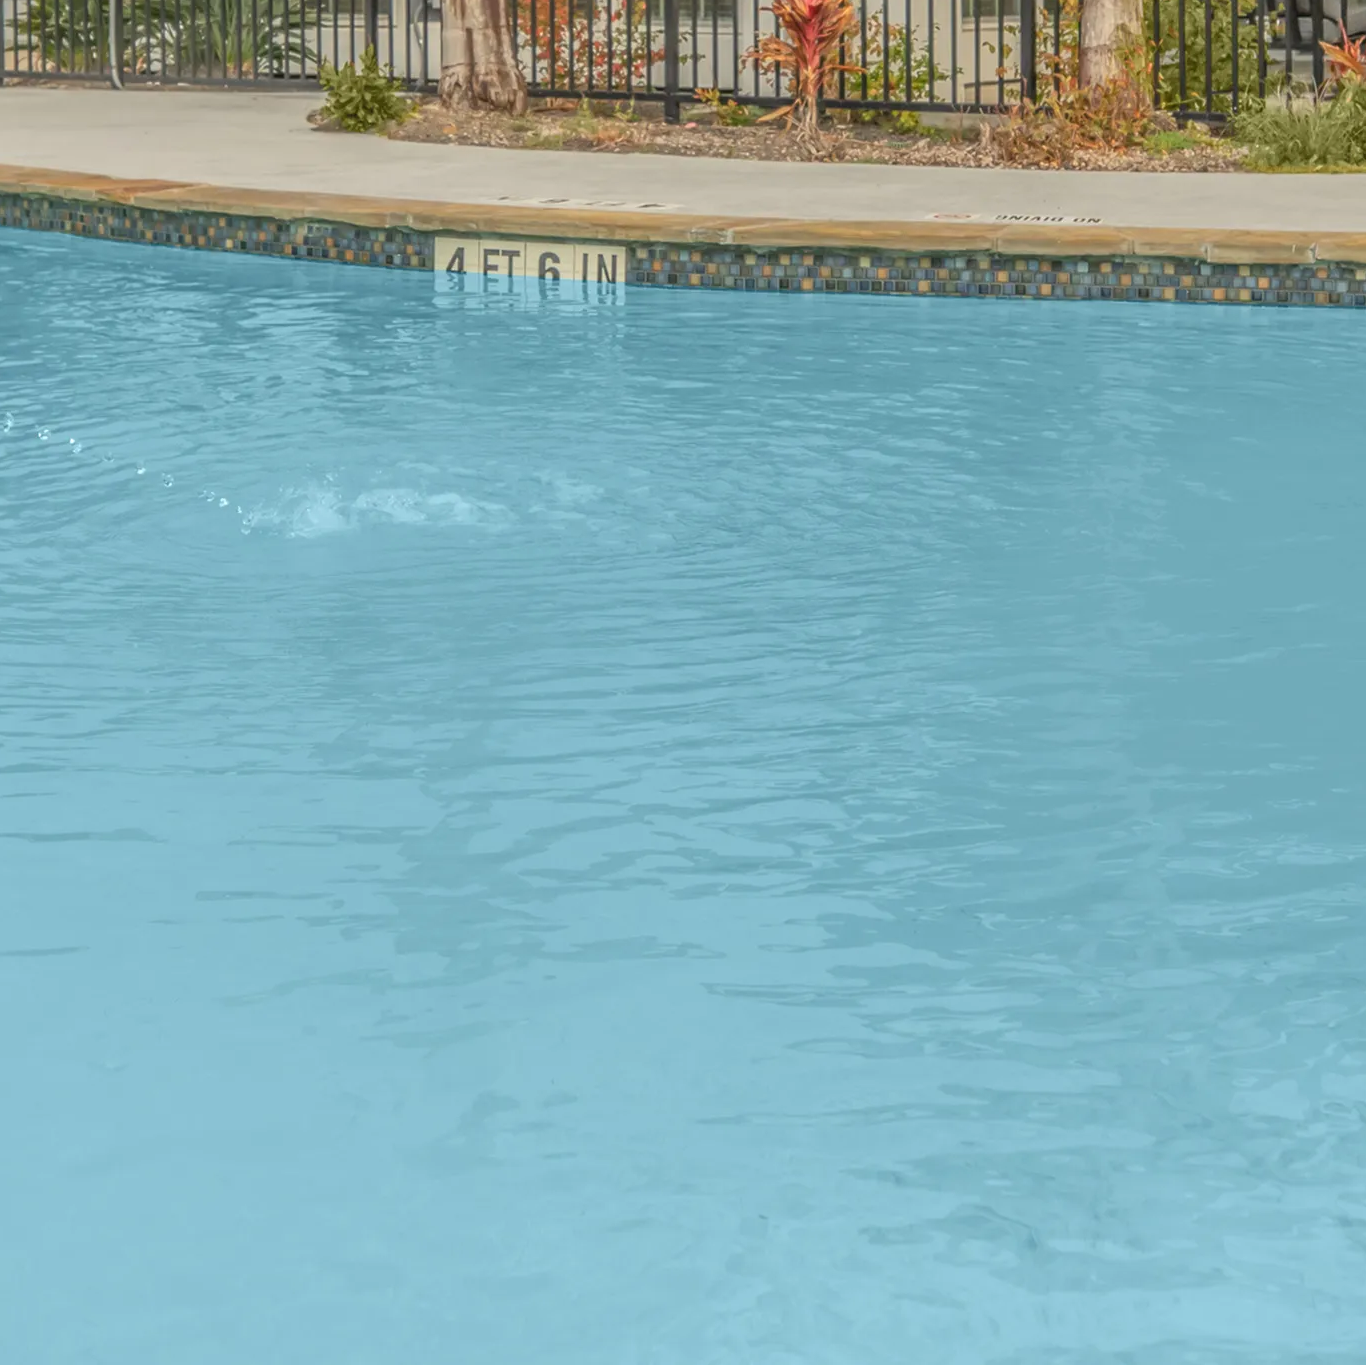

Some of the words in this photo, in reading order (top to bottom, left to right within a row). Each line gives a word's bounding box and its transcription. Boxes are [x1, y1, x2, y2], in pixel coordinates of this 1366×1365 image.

[446, 247, 467, 274] 4
[483, 249, 521, 277] FT
[538, 251, 561, 281] 6
[583, 253, 618, 283] IN
